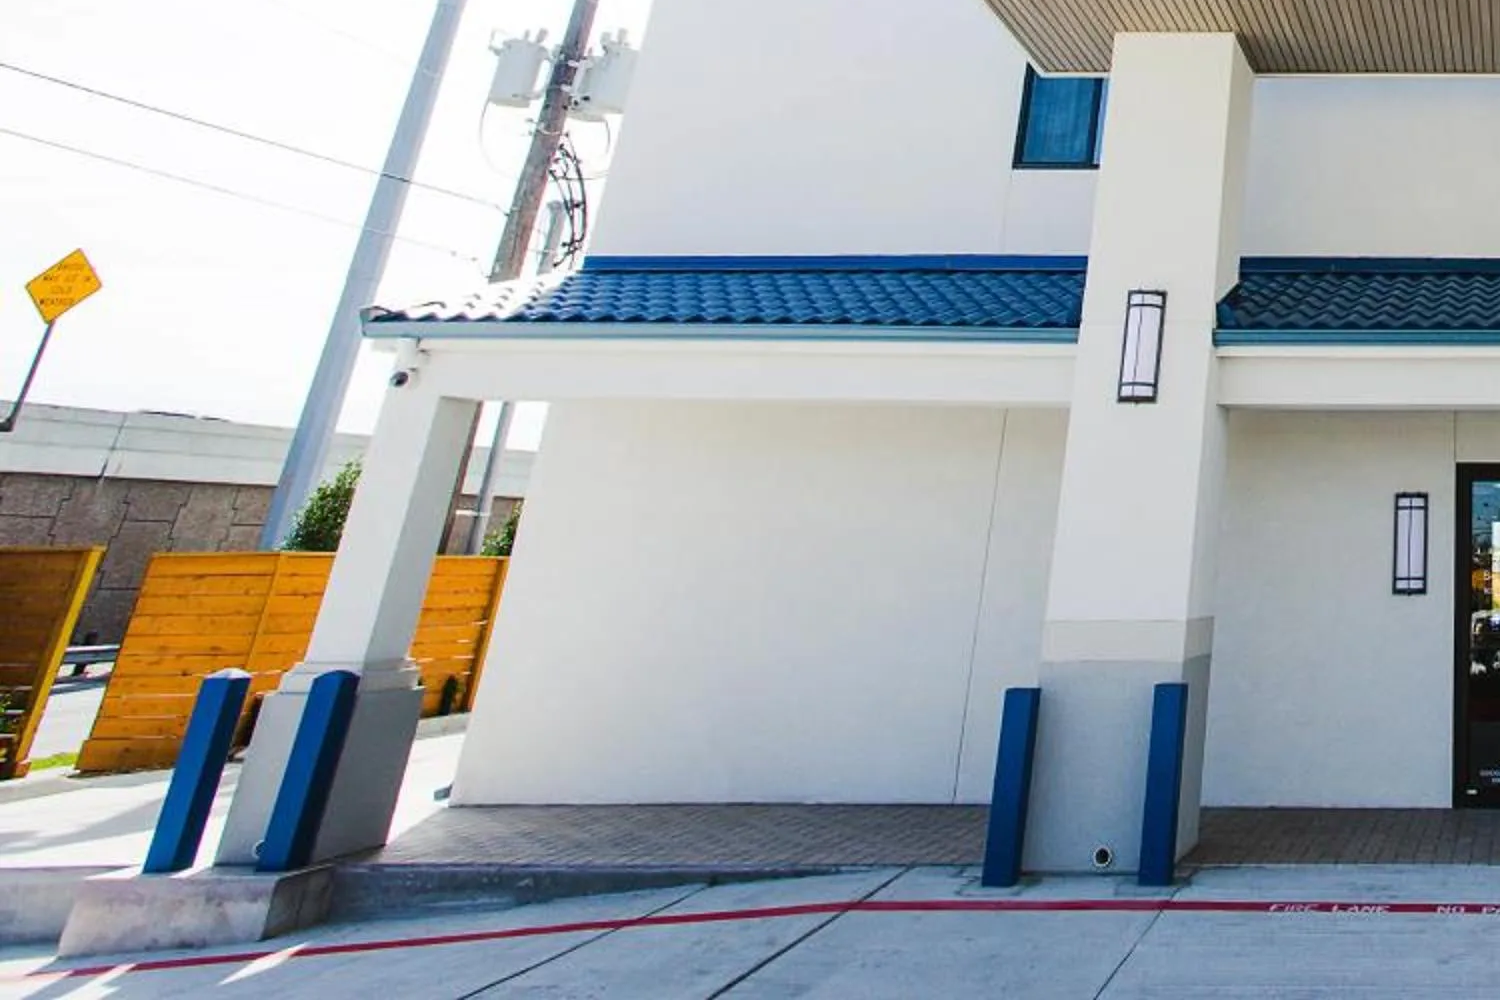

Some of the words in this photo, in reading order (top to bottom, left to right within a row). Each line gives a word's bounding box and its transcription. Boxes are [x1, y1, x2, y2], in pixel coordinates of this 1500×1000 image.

[1268, 903, 1319, 915] FIRE
[1329, 904, 1391, 916] LANE
[1436, 905, 1465, 916] NO
